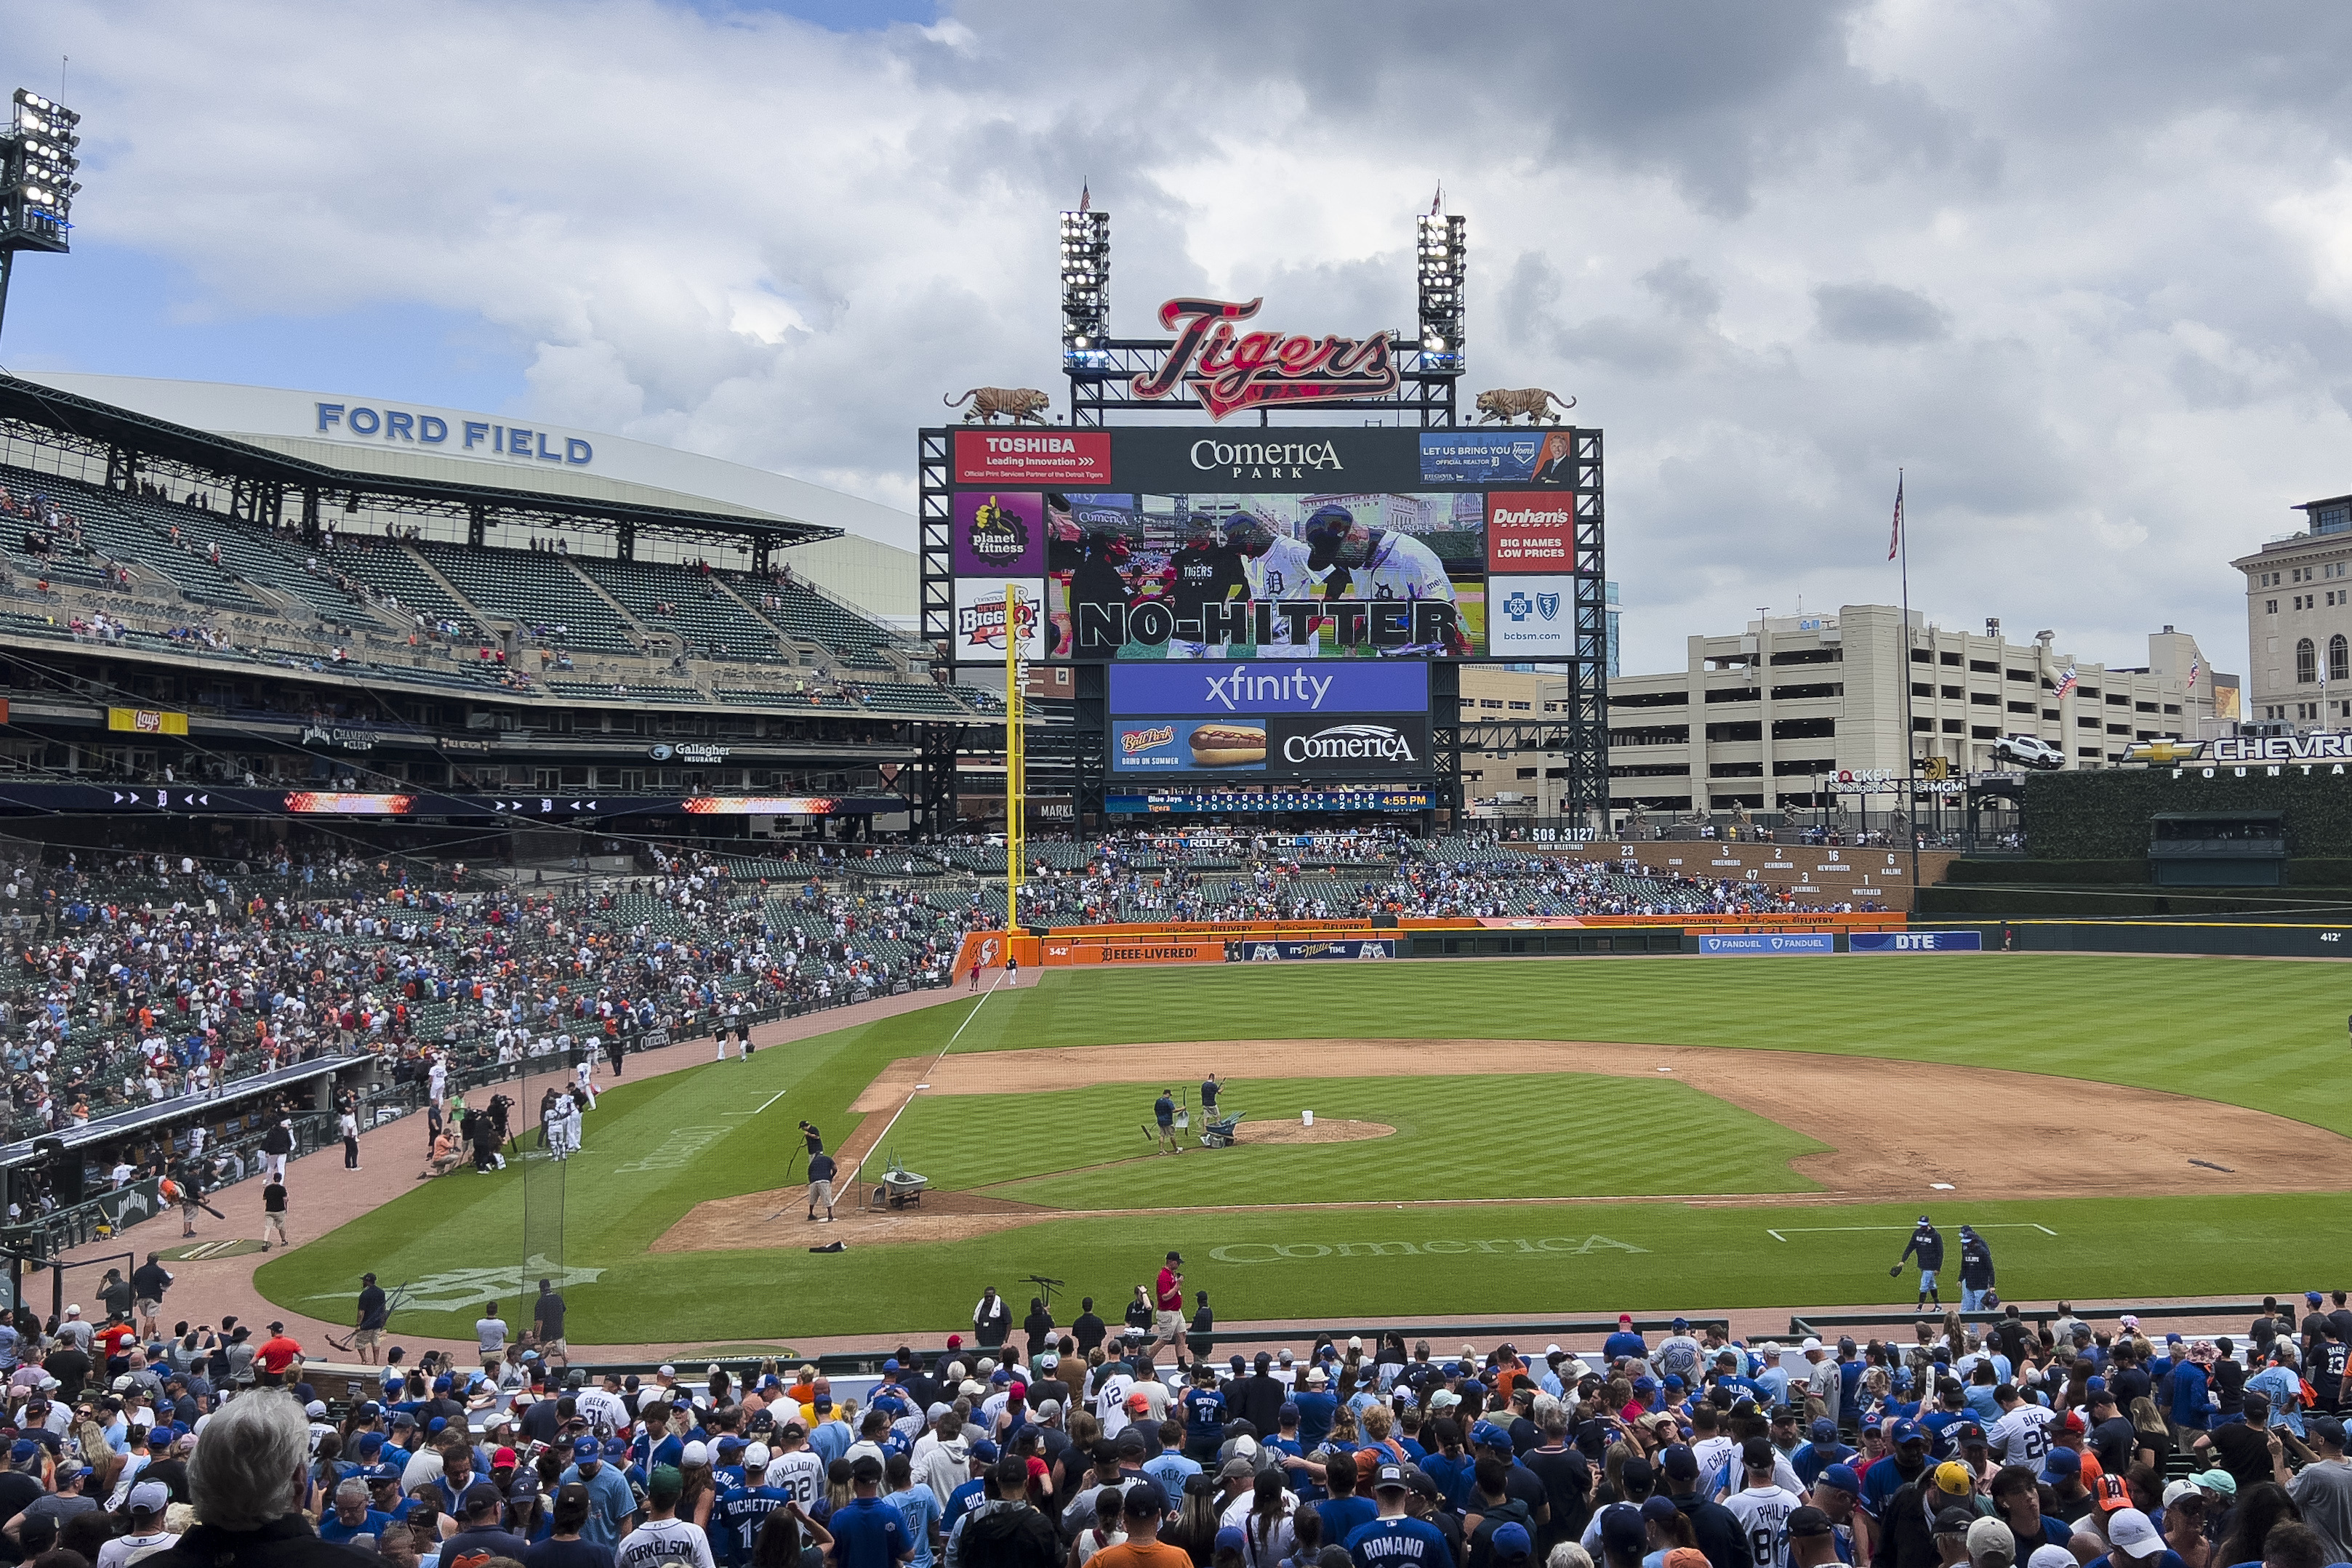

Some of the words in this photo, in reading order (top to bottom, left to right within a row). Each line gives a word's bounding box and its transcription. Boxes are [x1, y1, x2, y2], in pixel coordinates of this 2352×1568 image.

[1131, 297, 1399, 404] Tigers
[316, 402, 448, 444] FORD
[462, 419, 593, 464] FIELD
[986, 438, 1075, 453] TOSHIBA
[1512, 445, 1535, 454] Home
[987, 457, 1024, 467] Leading
[1026, 457, 1076, 466] Innovation
[1232, 467, 1303, 478] PARK
[1493, 507, 1568, 524] Dunham's
[973, 532, 1015, 546] planet
[1500, 539, 1520, 547] BIG
[1522, 538, 1562, 547] NAMES
[979, 544, 1024, 554] fitness
[1497, 549, 1522, 558] LOW
[1524, 549, 1565, 558] PRICES
[1183, 566, 1213, 578] TIGERS
[1079, 601, 1457, 647] NO-HITTER
[1013, 586, 1031, 697] ROCKET
[1504, 632, 1560, 641] bcbsm.com
[1205, 666, 1333, 710] xfinity
[137, 711, 160, 731] Lay's
[333, 728, 380, 743] CHAMPIONS
[1124, 733, 1147, 751] Ball
[1147, 727, 1172, 743] Park
[348, 741, 367, 749] CLUB
[675, 743, 731, 756] Gallagher
[1829, 769, 1893, 783] ROCKET
[1839, 784, 1885, 795] Mortgage
[1382, 796, 1407, 805] 4:55
[1409, 795, 1426, 805] PM
[1533, 828, 1556, 842] 508
[1564, 827, 1594, 842] 3127
[1621, 845, 1634, 856] 23
[1722, 845, 1729, 856] 5
[1775, 848, 1781, 859] 2
[1827, 851, 1839, 861] 16
[1887, 853, 1895, 864] 6
[1745, 869, 1758, 880] 47
[1802, 872, 1809, 883] 3
[1863, 875, 1869, 885] 1
[1895, 935, 1935, 949] DTE
[2320, 933, 2341, 942] 412'
[1049, 947, 1069, 956] 342'
[1300, 943, 1335, 958] Miller
[118, 1197, 130, 1219] JIM
[129, 1190, 148, 1216] BEAM
[1671, 1353, 1693, 1367] 20
[2327, 1356, 2345, 1375] 13
[1834, 1374, 1839, 1391] 3
[585, 1396, 610, 1410] GREENE
[1105, 1386, 1123, 1407] 12
[585, 1408, 602, 1426] 31
[1199, 1407, 1214, 1422] 11
[1944, 1436, 1961, 1460] 2
[776, 1462, 814, 1479] HALLADAY
[627, 1539, 693, 1563] TORKELSON
[1362, 1536, 1424, 1561] ROMANO
